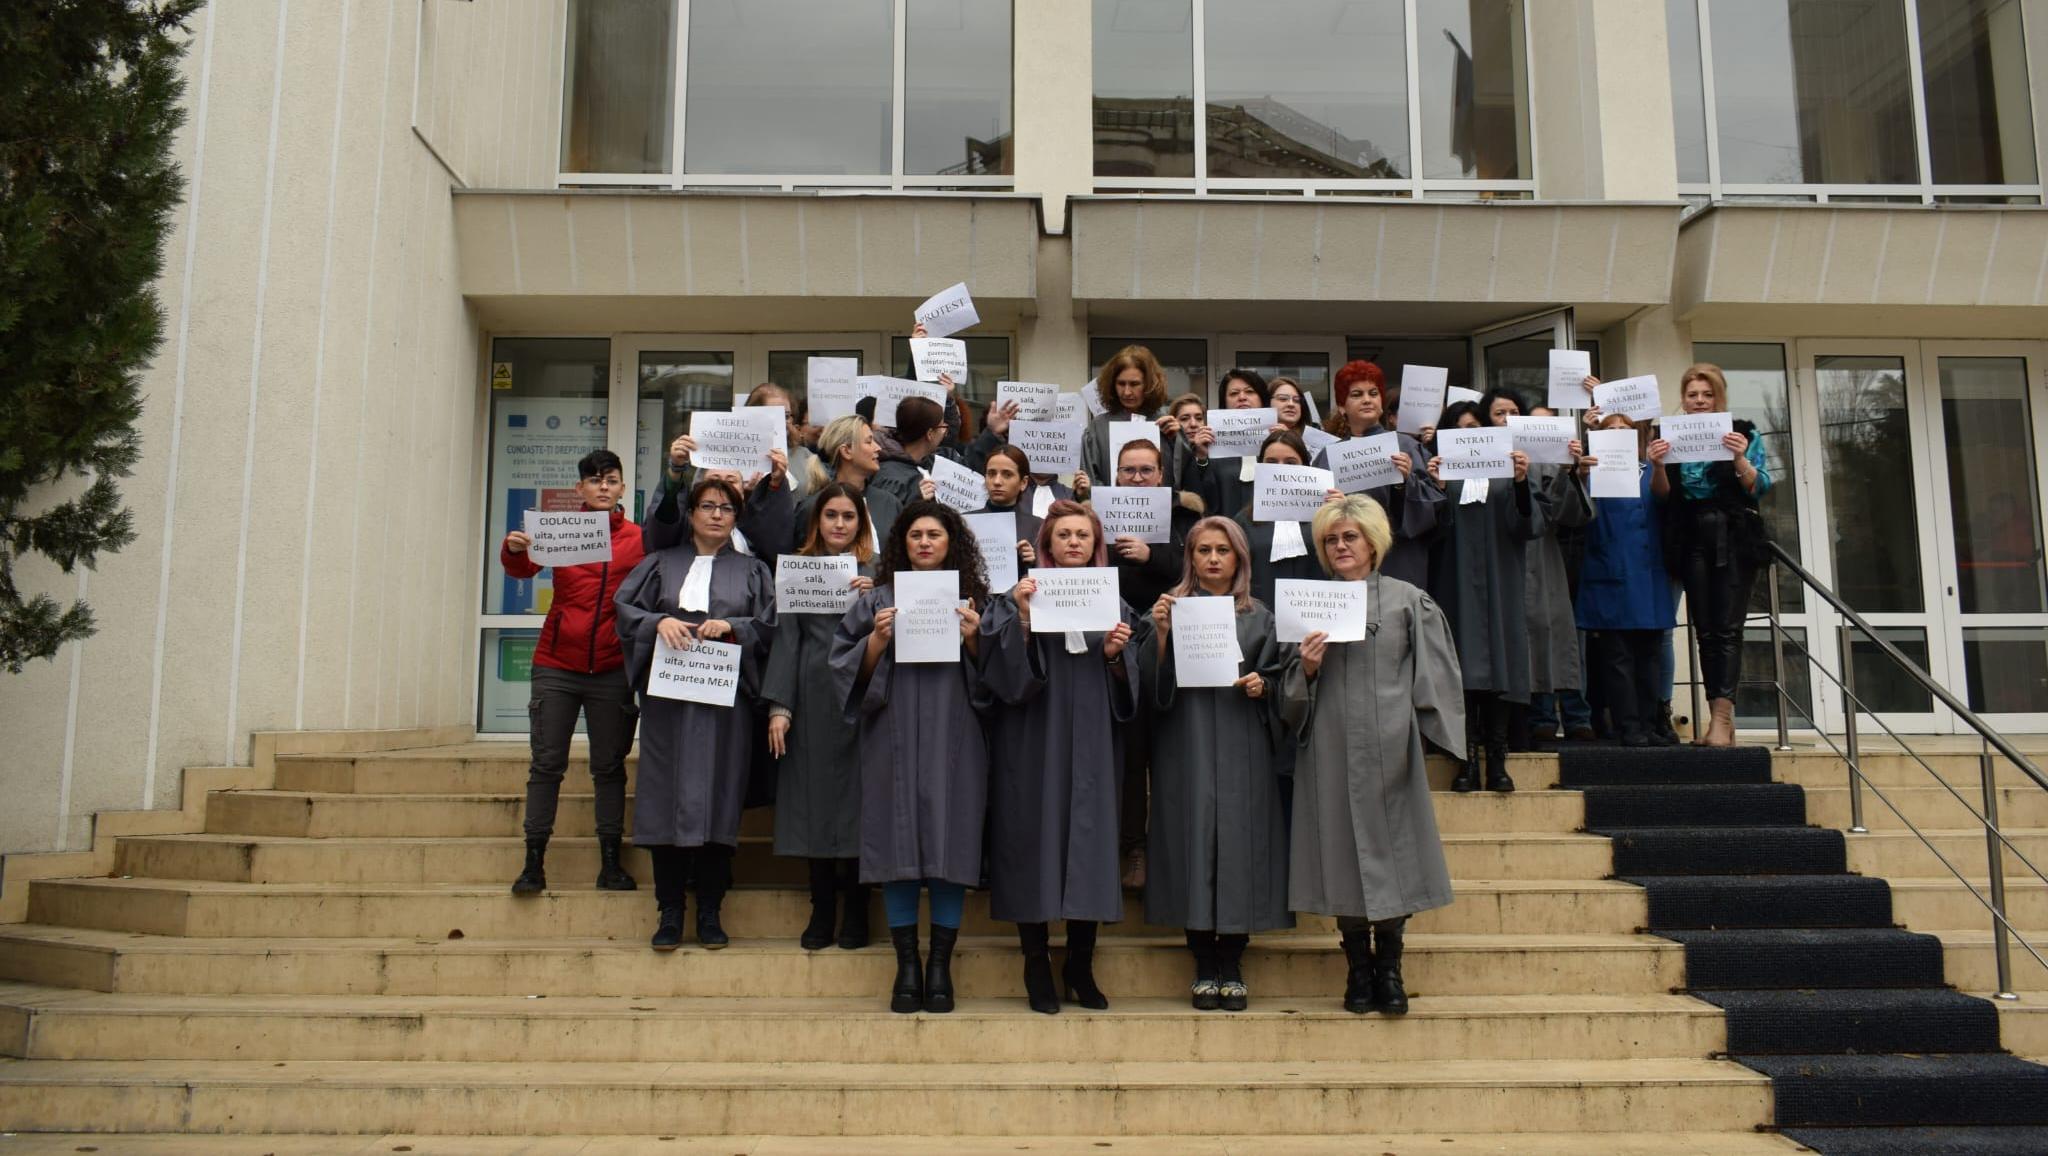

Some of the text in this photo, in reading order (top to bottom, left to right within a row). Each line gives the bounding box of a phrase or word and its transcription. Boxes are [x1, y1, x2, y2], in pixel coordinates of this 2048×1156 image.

[1036, 386, 1045, 394] hai
[717, 418, 749, 427] MEREU
[1223, 417, 1261, 426] MUNCIM
[1025, 430, 1066, 440] NU VREM
[1021, 442, 1068, 452] MAJORĂRI
[1343, 446, 1382, 460] MUNCIM
[1029, 456, 1066, 464] LARIALE
[1447, 460, 1504, 470] LEGALITATE!
[1340, 466, 1349, 474] PE
[954, 472, 974, 486] VREM
[1273, 474, 1317, 483] MUNCIM
[940, 480, 978, 501] SALARIILE
[1266, 488, 1276, 496] PE
[1106, 510, 1156, 520] INTEGRAL
[540, 518, 580, 526] CIOLACU
[1104, 524, 1153, 532] SALARIILE
[534, 530, 556, 540] uita,
[596, 530, 603, 538] fi
[533, 542, 607, 554] de partea MEA!
[782, 560, 820, 570] CIOLACU
[824, 562, 838, 570] hai
[804, 575, 826, 584] sală,
[812, 588, 832, 596] mori
[836, 588, 847, 596] de
[664, 656, 686, 667] uita,
[688, 661, 710, 670] urna
[726, 664, 732, 672] fi
[659, 670, 734, 688] de partea MEA!
